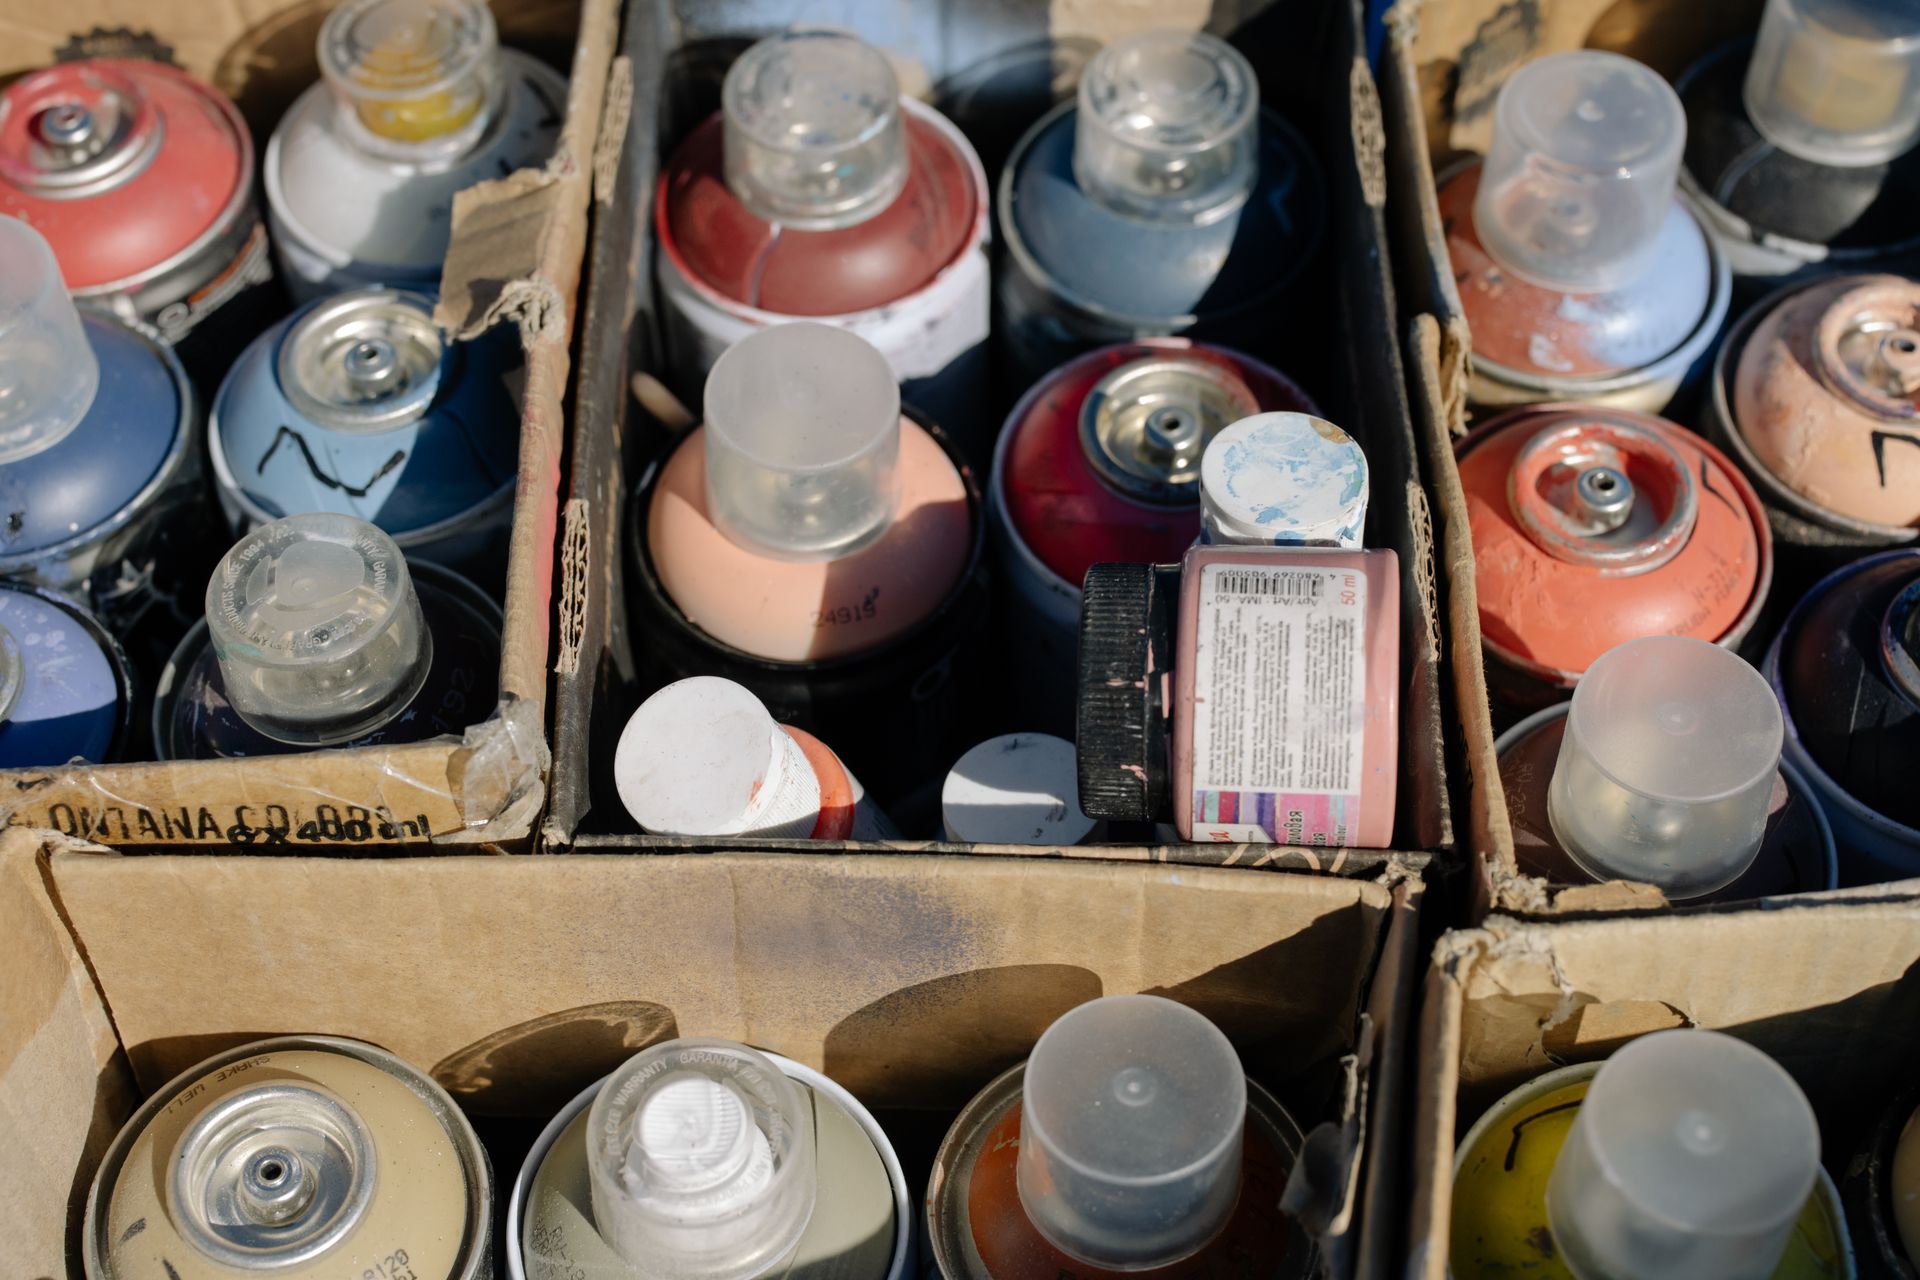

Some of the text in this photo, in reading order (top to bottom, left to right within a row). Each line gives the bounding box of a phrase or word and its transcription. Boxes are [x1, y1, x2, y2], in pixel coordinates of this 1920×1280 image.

[1340, 573, 1357, 606] 50 ml
[163, 1055, 271, 1115] SHAKE WELL
[612, 1051, 740, 1107] WARRANTY GARANTIA
